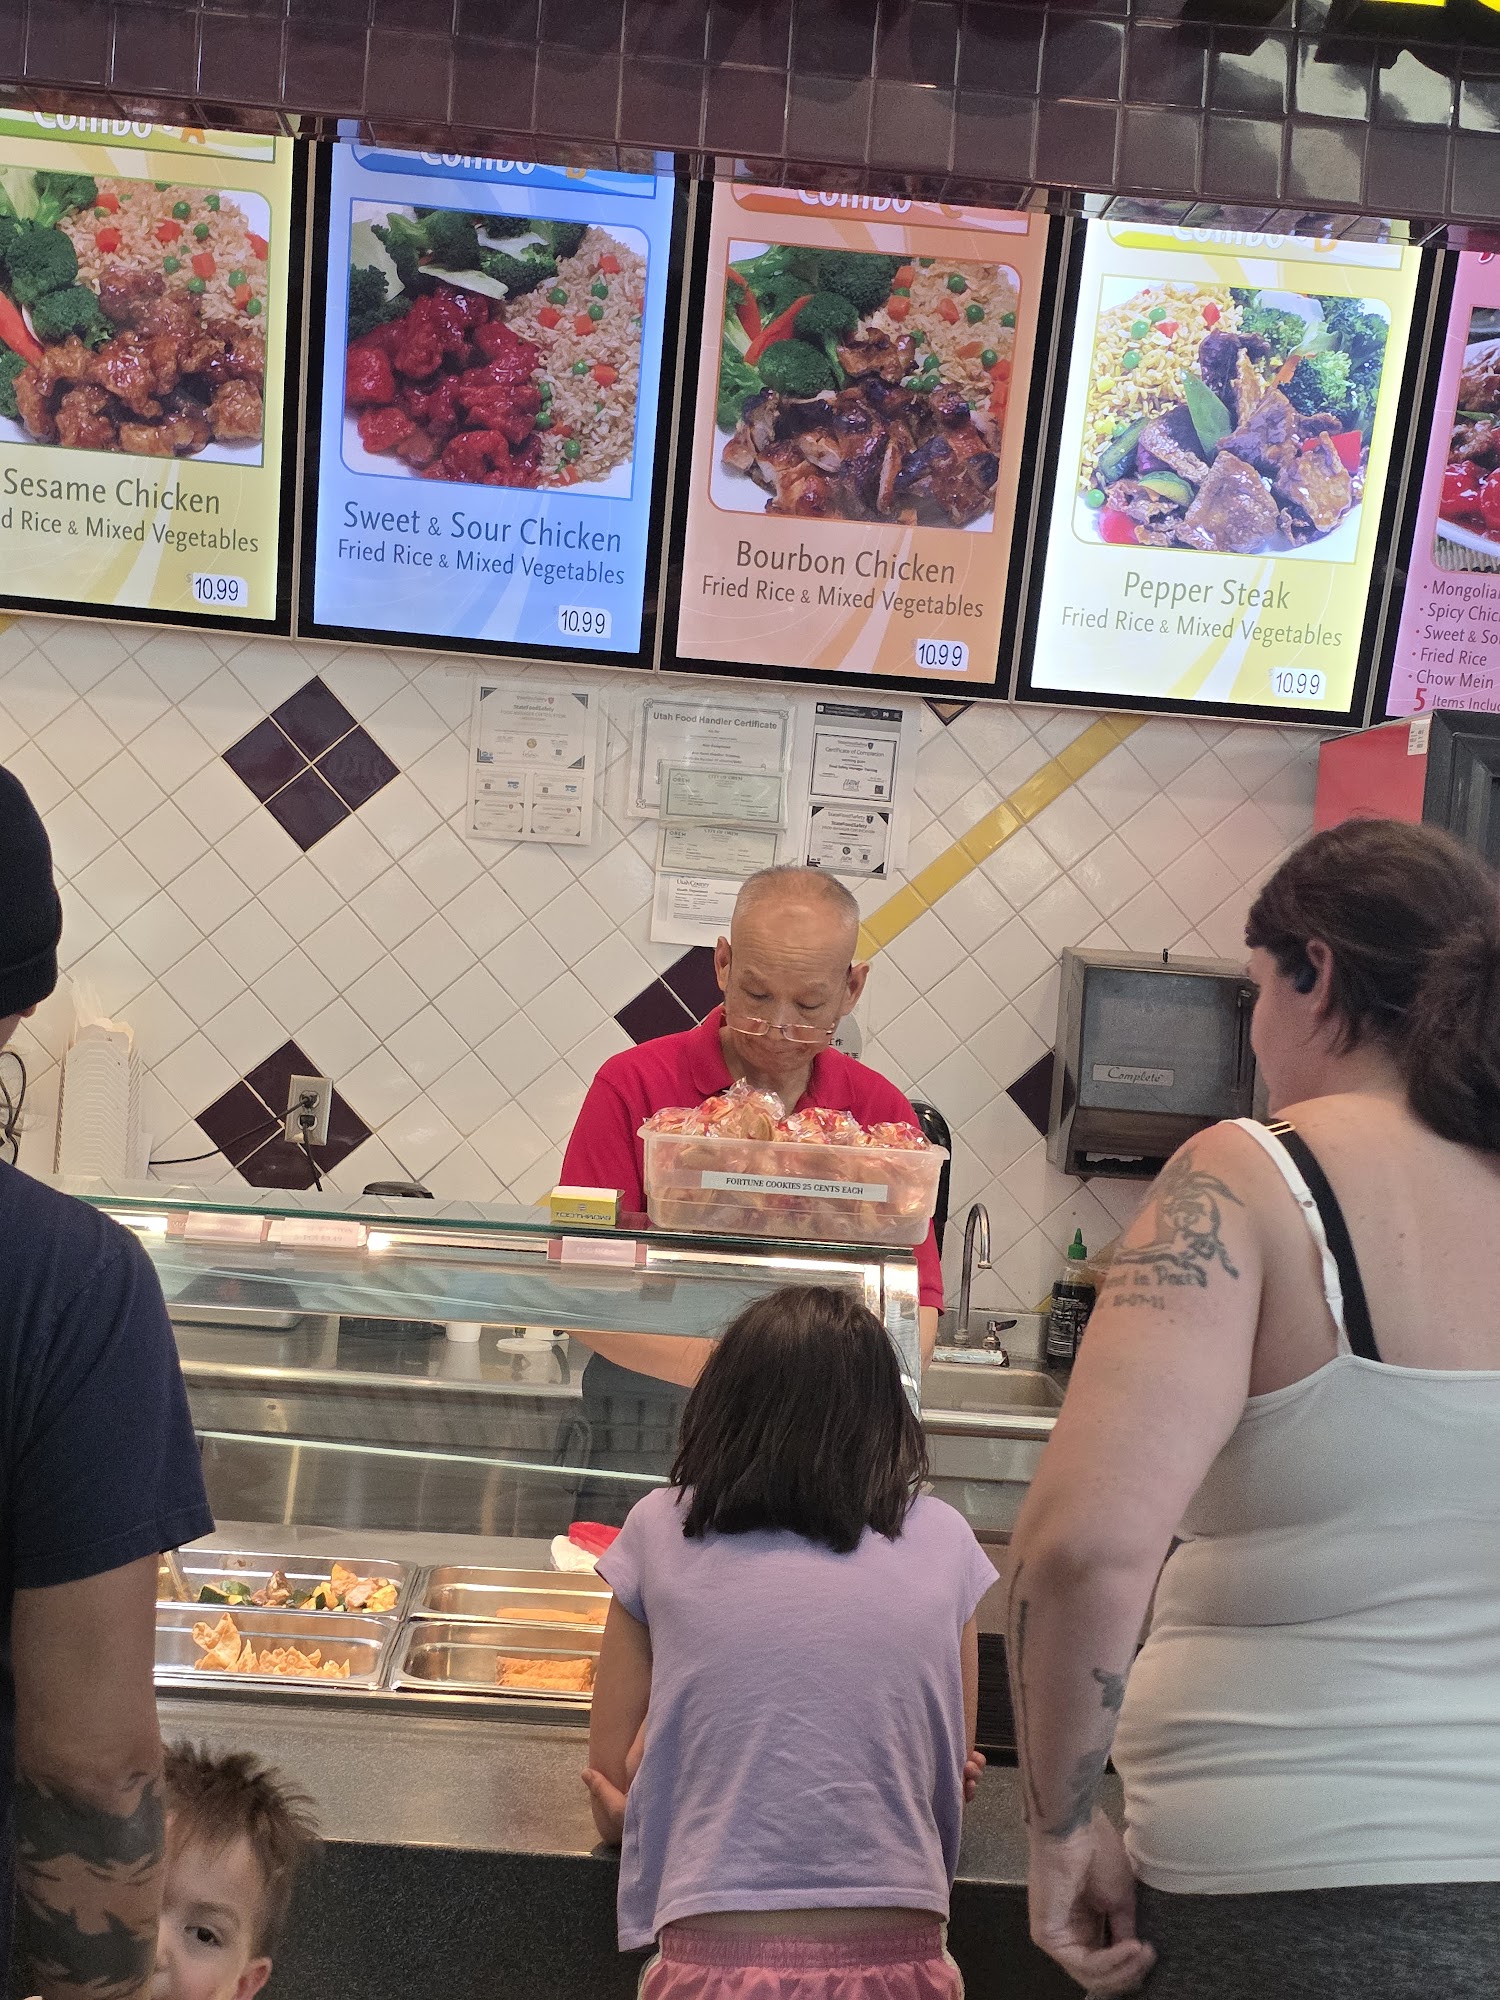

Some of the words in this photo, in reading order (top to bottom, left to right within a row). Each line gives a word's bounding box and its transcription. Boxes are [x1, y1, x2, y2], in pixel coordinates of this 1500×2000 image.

[4, 468, 106, 503] Sesame
[116, 478, 220, 514] Chicken
[21, 510, 62, 533] Rice
[68, 521, 79, 535] &
[87, 516, 145, 541] Mixed
[152, 522, 259, 552] Vegetables
[344, 501, 420, 534] Sweet
[428, 516, 442, 536] &
[451, 511, 511, 542] Sour
[520, 518, 621, 553] Chicken
[338, 538, 385, 562] Fried
[393, 543, 433, 567] Rice
[439, 553, 450, 568] &
[456, 550, 514, 575] Mixed
[521, 556, 625, 584] Vegetables
[737, 541, 845, 575] Bourbon
[855, 550, 955, 584] Chicken
[195, 577, 239, 601] 10.99
[702, 575, 748, 598] Fried
[756, 580, 795, 602] Rice
[800, 589, 811, 604] &
[818, 585, 875, 609] Mixed
[882, 590, 984, 618] Vegetables
[1124, 571, 1213, 609] Pepper
[1220, 579, 1291, 610] Steak
[561, 610, 605, 634] 10.99
[1427, 603, 1465, 623] Spicy
[1468, 606, 1500, 622] Chic
[1062, 606, 1108, 629] Fried
[1115, 610, 1154, 633] Rice
[1159, 619, 1170, 634] &
[1177, 615, 1234, 639] Mixed
[1241, 620, 1343, 648] Vegetables
[1423, 625, 1465, 643] Sweet
[1468, 630, 1477, 643] &
[1481, 629, 1500, 645] So
[918, 644, 963, 667] 10.99
[1420, 647, 1455, 664] Fried
[1459, 650, 1487, 666] Rice
[1275, 672, 1320, 695] 10.99
[1416, 669, 1455, 687] Chow
[1459, 672, 1494, 689] Mein
[1413, 687, 1428, 712] 5
[1432, 695, 1465, 709] Items
[653, 712, 673, 721] Utah
[676, 714, 697, 723] Food
[699, 716, 732, 726] Handler
[734, 718, 777, 730] Certificate
[1107, 1067, 1164, 1083] Complete
[726, 1177, 764, 1188] FORTUNE
[766, 1180, 800, 1190] COOKIES
[802, 1183, 812, 1191] 25
[814, 1184, 840, 1193] CENTS
[842, 1186, 864, 1195] EACH
